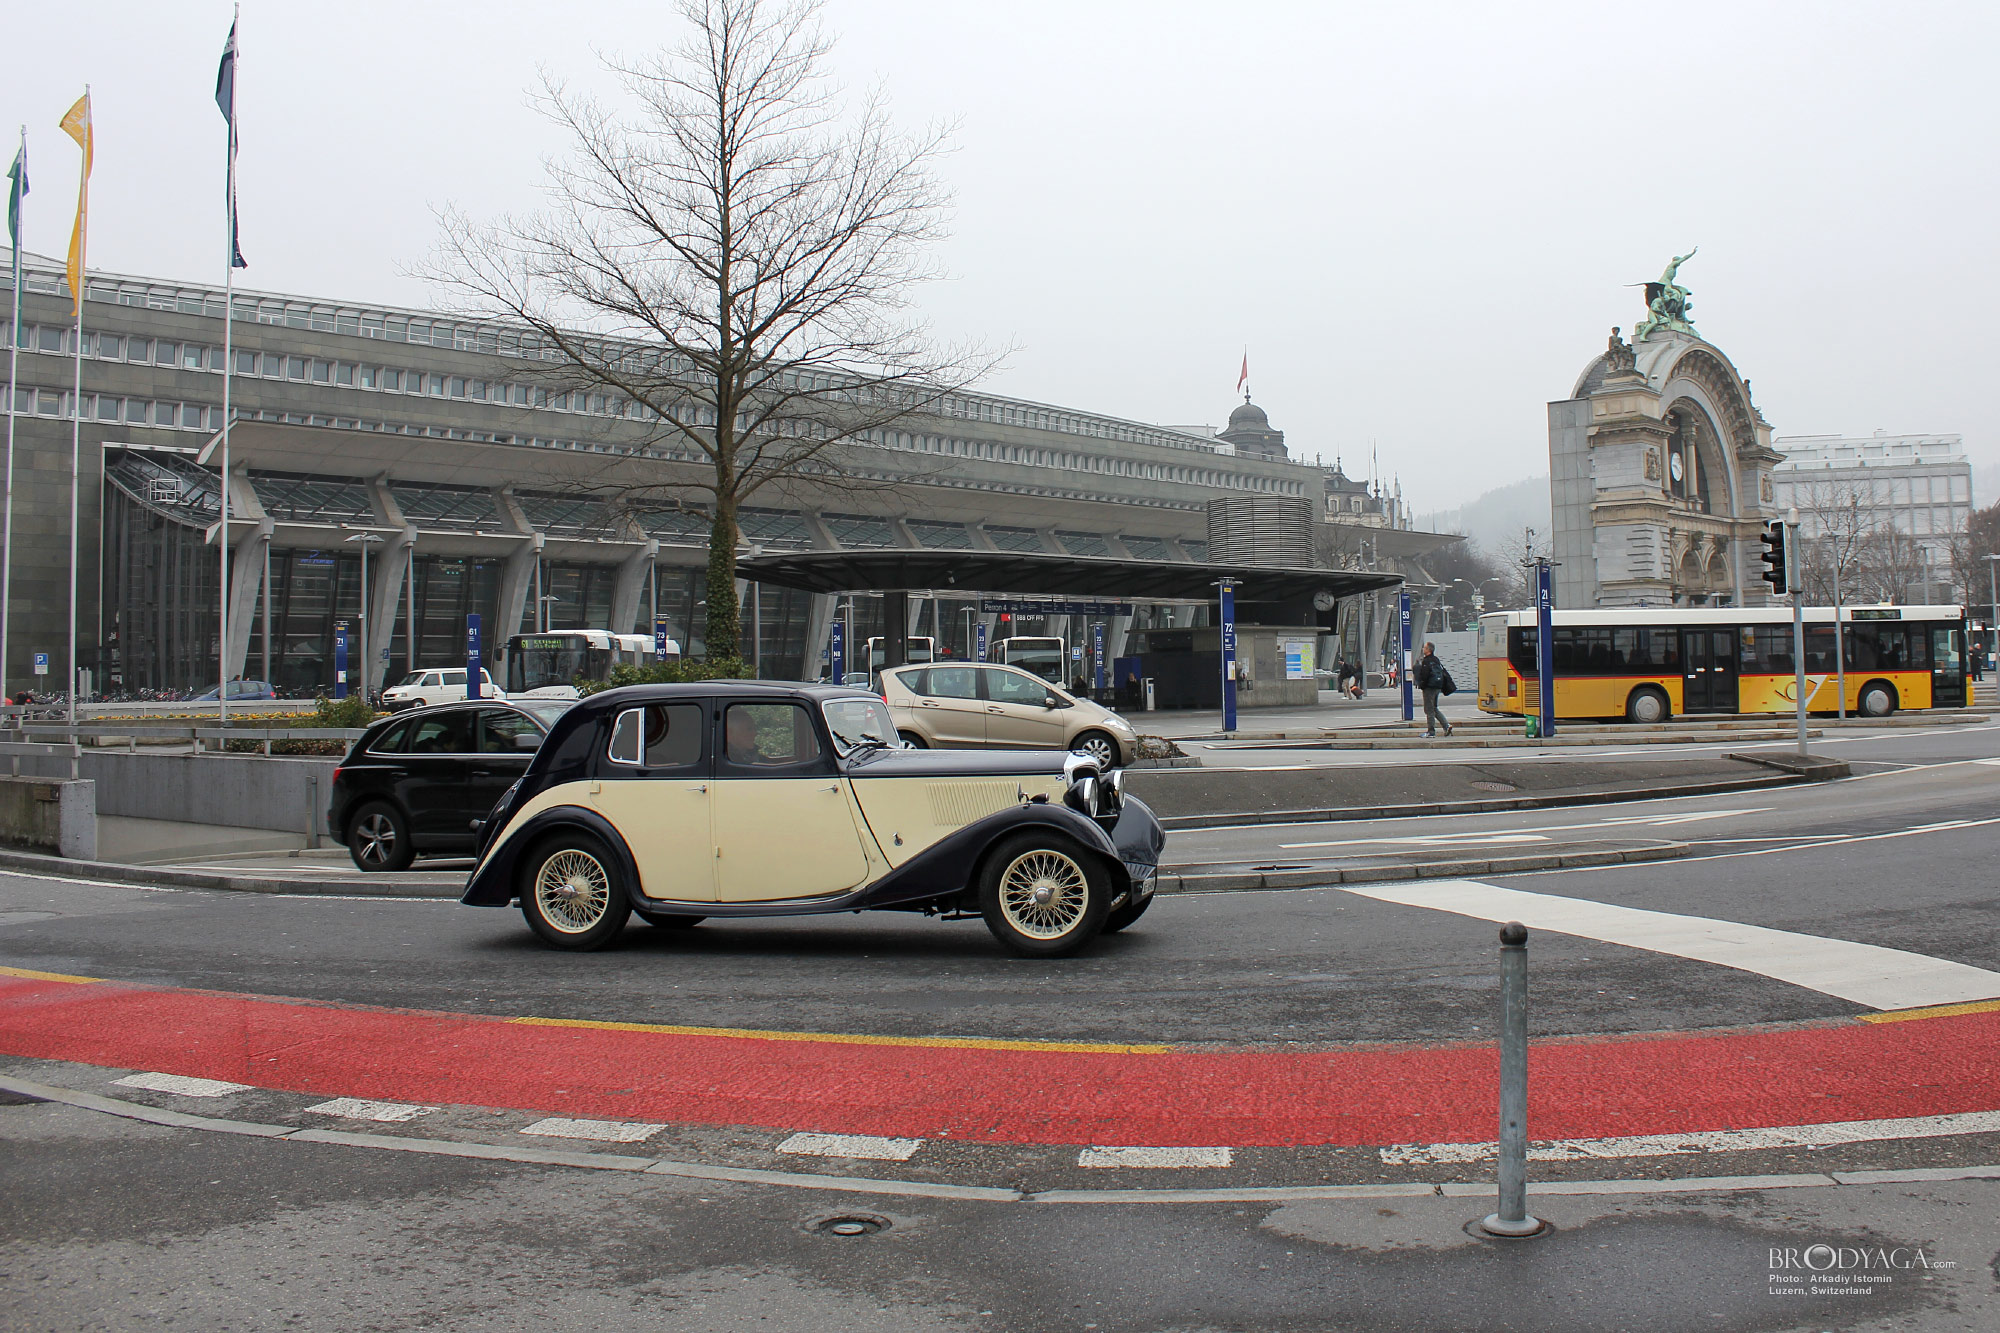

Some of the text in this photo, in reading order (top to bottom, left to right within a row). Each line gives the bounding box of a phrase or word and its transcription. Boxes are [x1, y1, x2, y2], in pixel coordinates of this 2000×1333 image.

[1541, 588, 1549, 600] 21
[984, 603, 1002, 611] Perron
[1402, 611, 1410, 620] 53
[468, 627, 477, 636] 61
[1224, 622, 1233, 633] 72
[656, 631, 665, 639] 73
[336, 637, 344, 645] 71
[521, 639, 529, 649] 61
[37, 655, 44, 664] P
